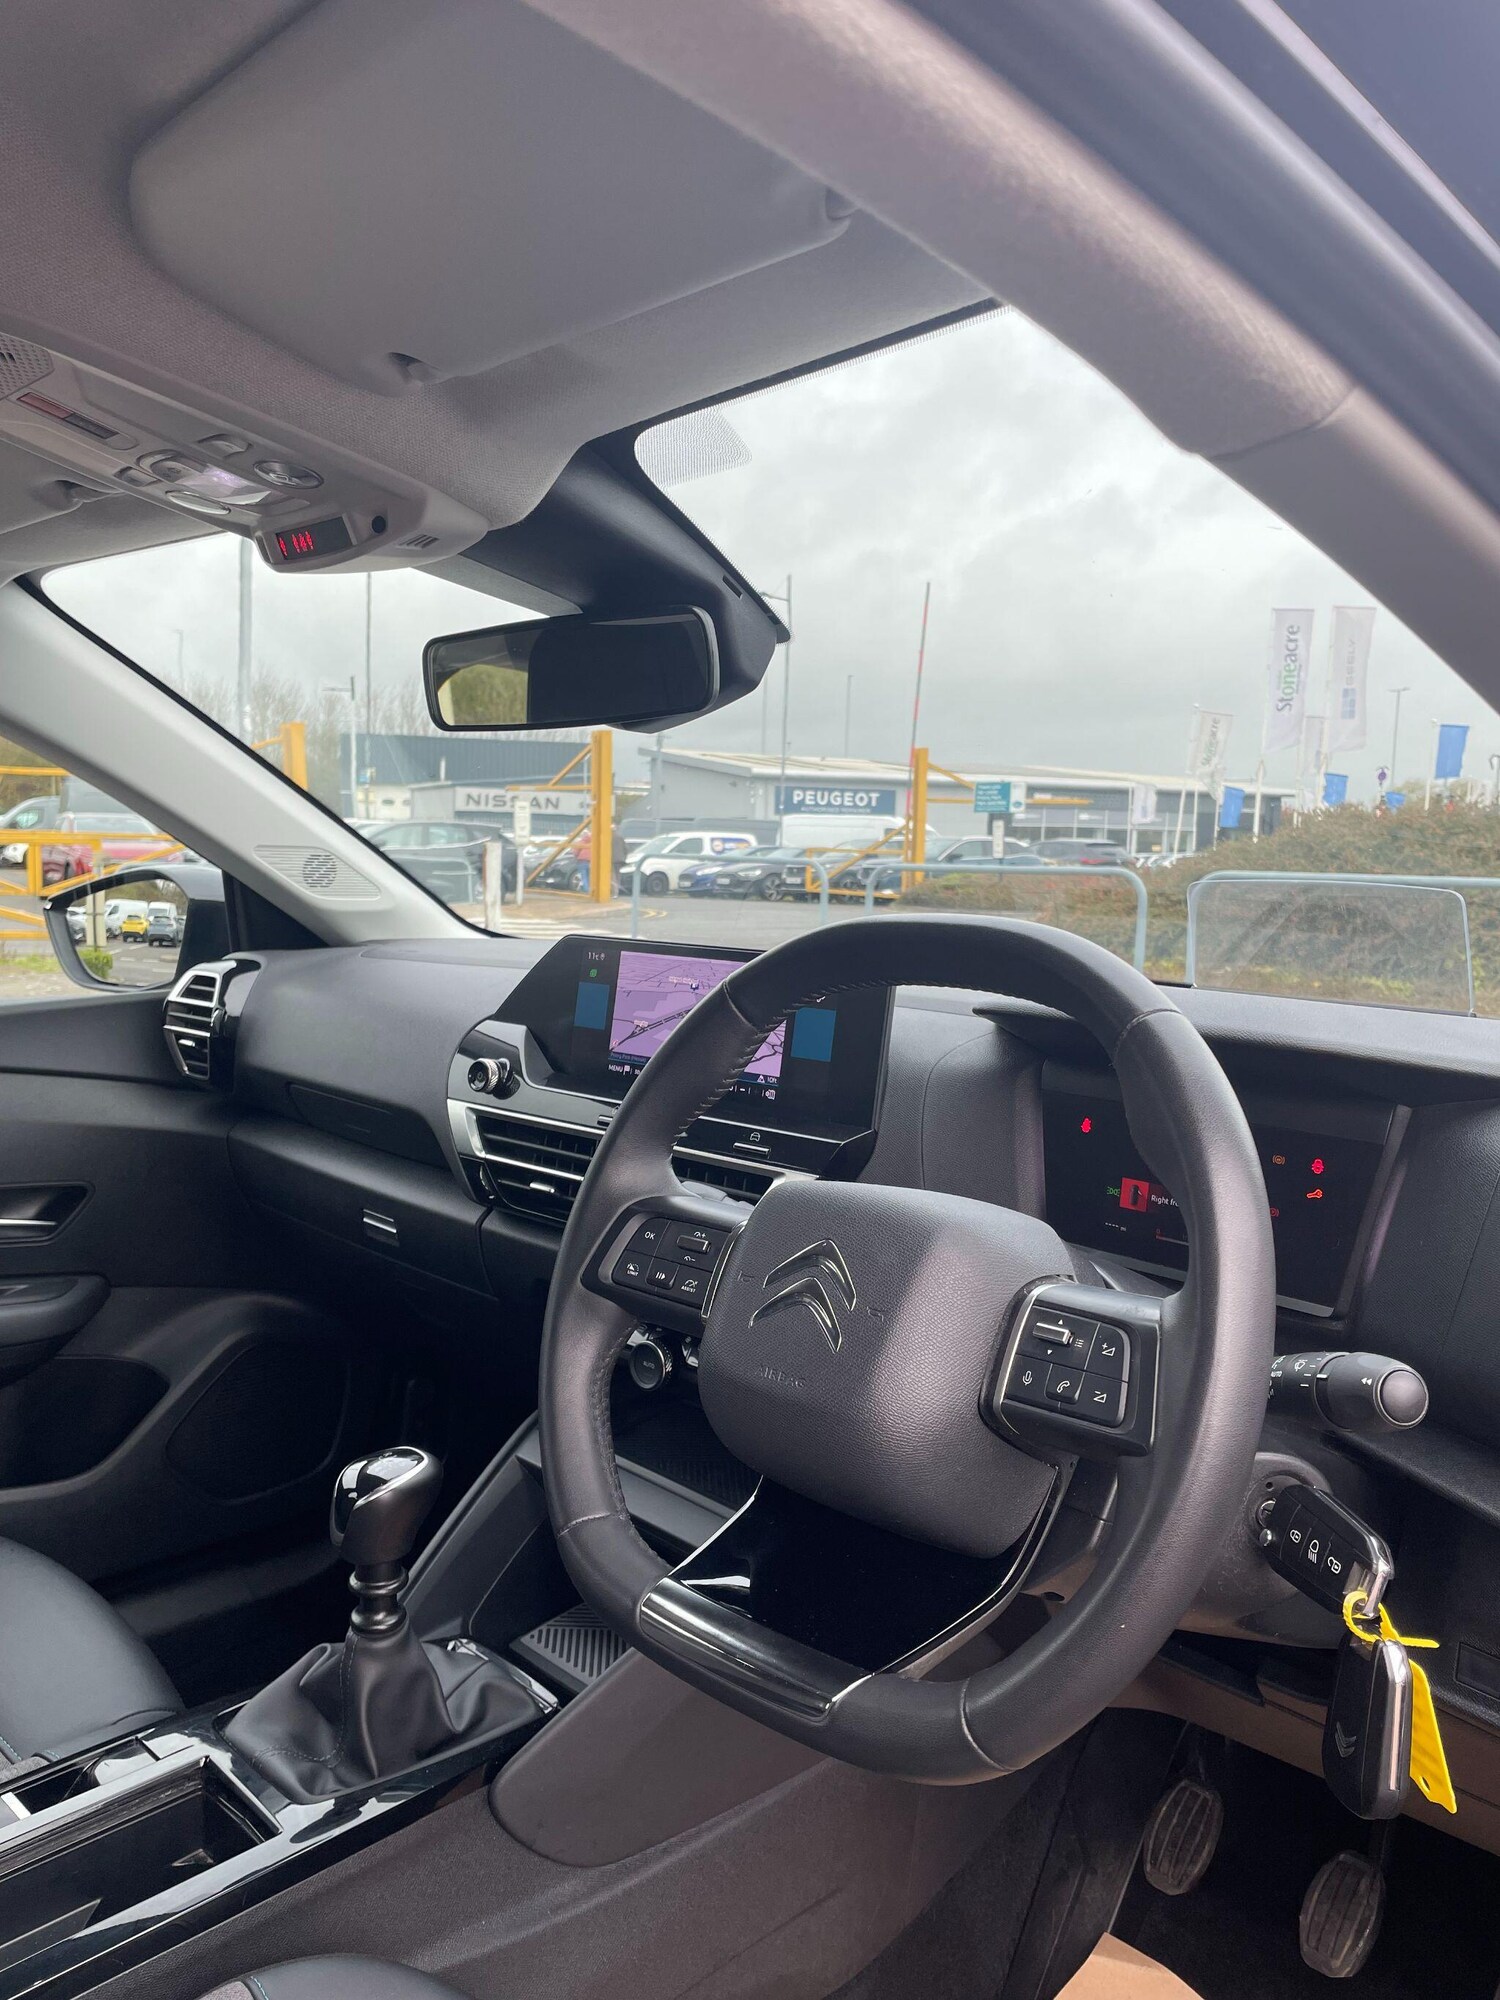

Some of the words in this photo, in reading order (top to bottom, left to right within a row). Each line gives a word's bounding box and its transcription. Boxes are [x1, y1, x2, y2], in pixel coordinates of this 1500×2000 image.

[1275, 624, 1301, 713] Stoneacre
[792, 790, 881, 807] PEUGEOT
[1150, 1194, 1169, 1205] Right
[644, 1231, 656, 1241] OK
